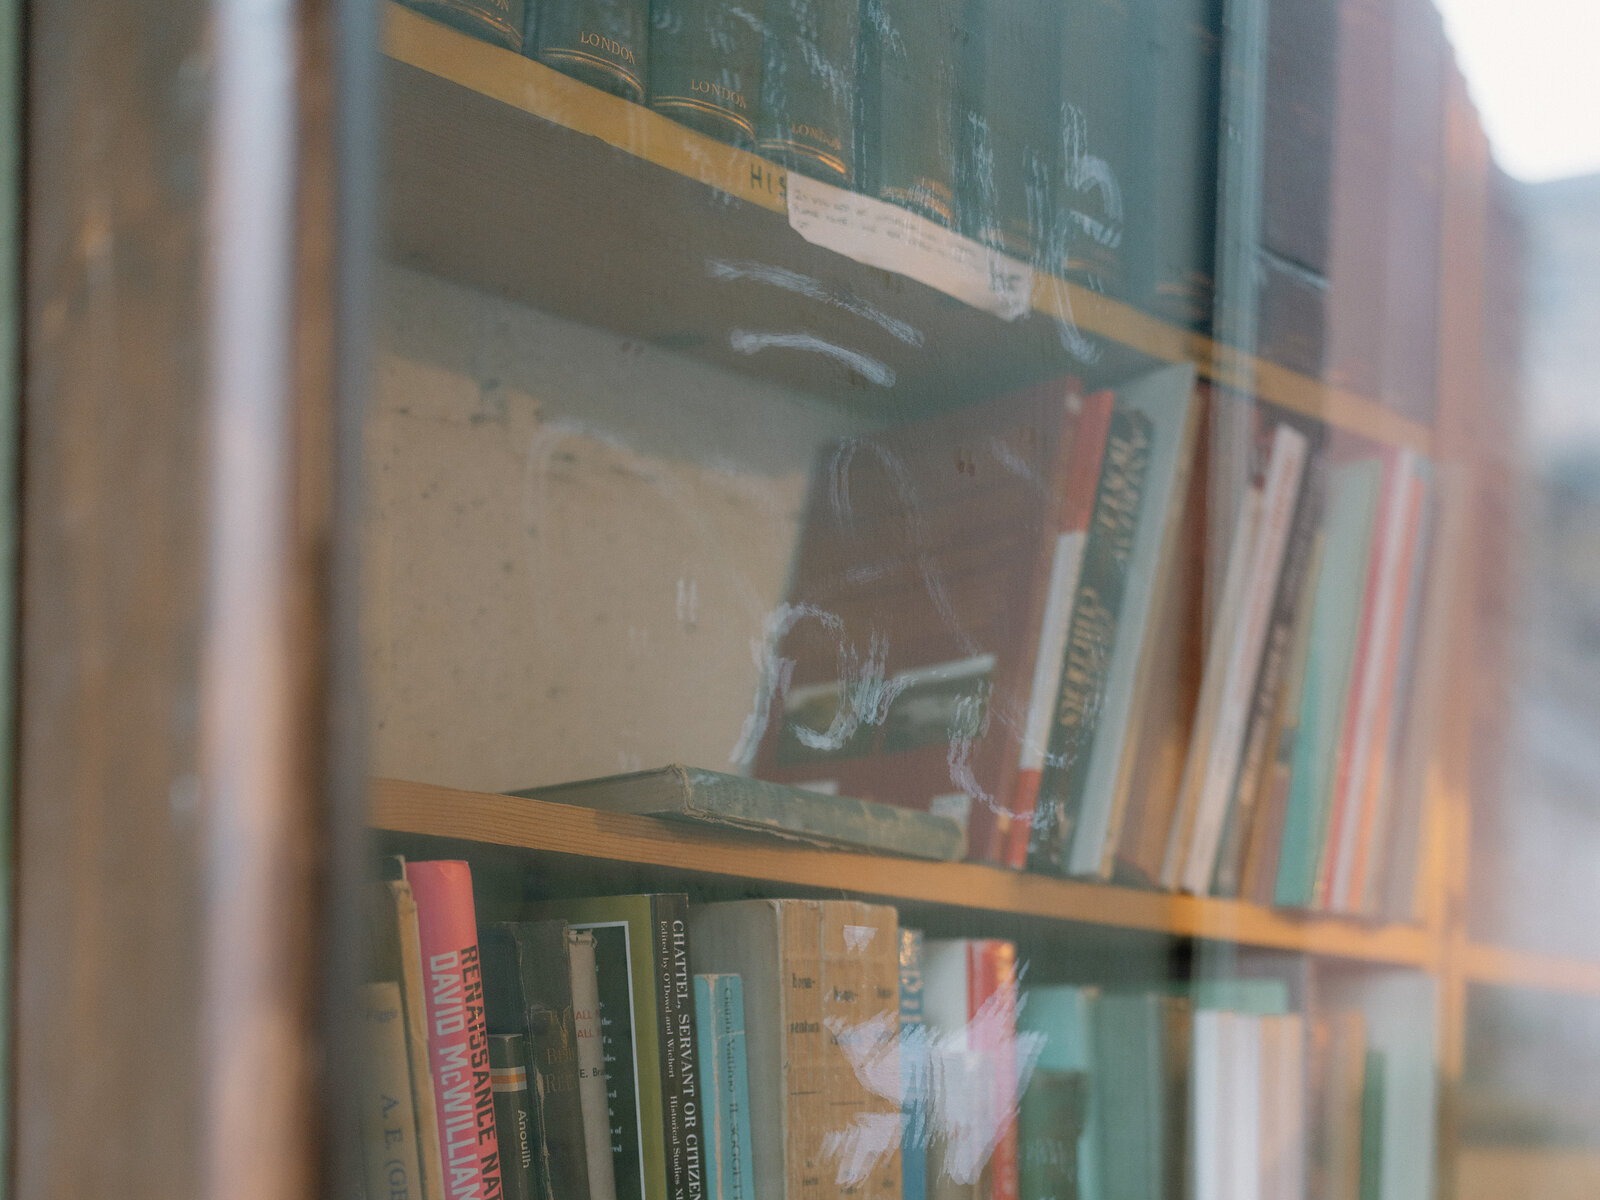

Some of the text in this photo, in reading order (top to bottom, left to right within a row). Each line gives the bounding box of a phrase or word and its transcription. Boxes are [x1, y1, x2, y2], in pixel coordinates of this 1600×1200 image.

[580, 31, 637, 65] LONDON
[690, 78, 747, 109] LONDON
[660, 920, 669, 954] Edited
[661, 957, 670, 969] by
[430, 950, 465, 1037] DAVID
[663, 973, 672, 1013] O'Dowd
[666, 1016, 674, 1035] and
[461, 944, 498, 1147] RENAISSANCE
[678, 1014, 695, 1097] SERVANT
[670, 1095, 680, 1145] Historical
[683, 1102, 697, 1128] OR
[517, 1109, 530, 1169] Anouilh
[673, 1148, 682, 1185] Studies
